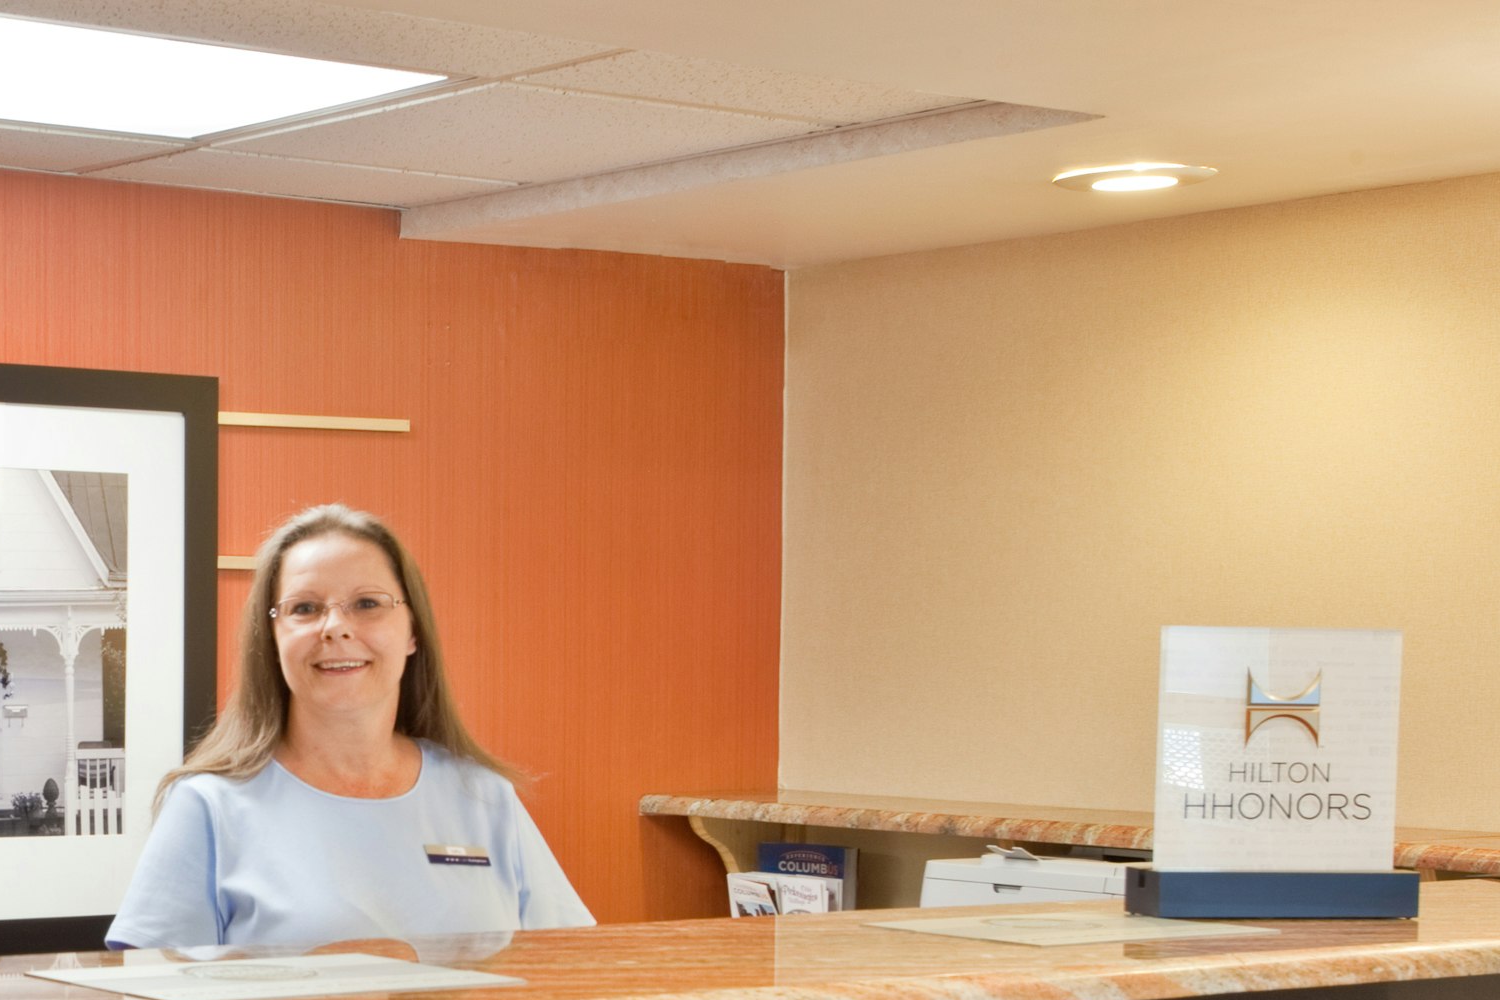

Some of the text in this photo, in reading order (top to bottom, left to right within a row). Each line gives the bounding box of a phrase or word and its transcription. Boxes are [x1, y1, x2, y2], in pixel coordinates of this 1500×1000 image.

[1229, 762, 1331, 783] HILTON
[1184, 792, 1372, 821] HHONORS
[778, 861, 838, 875] COLUMBUS
